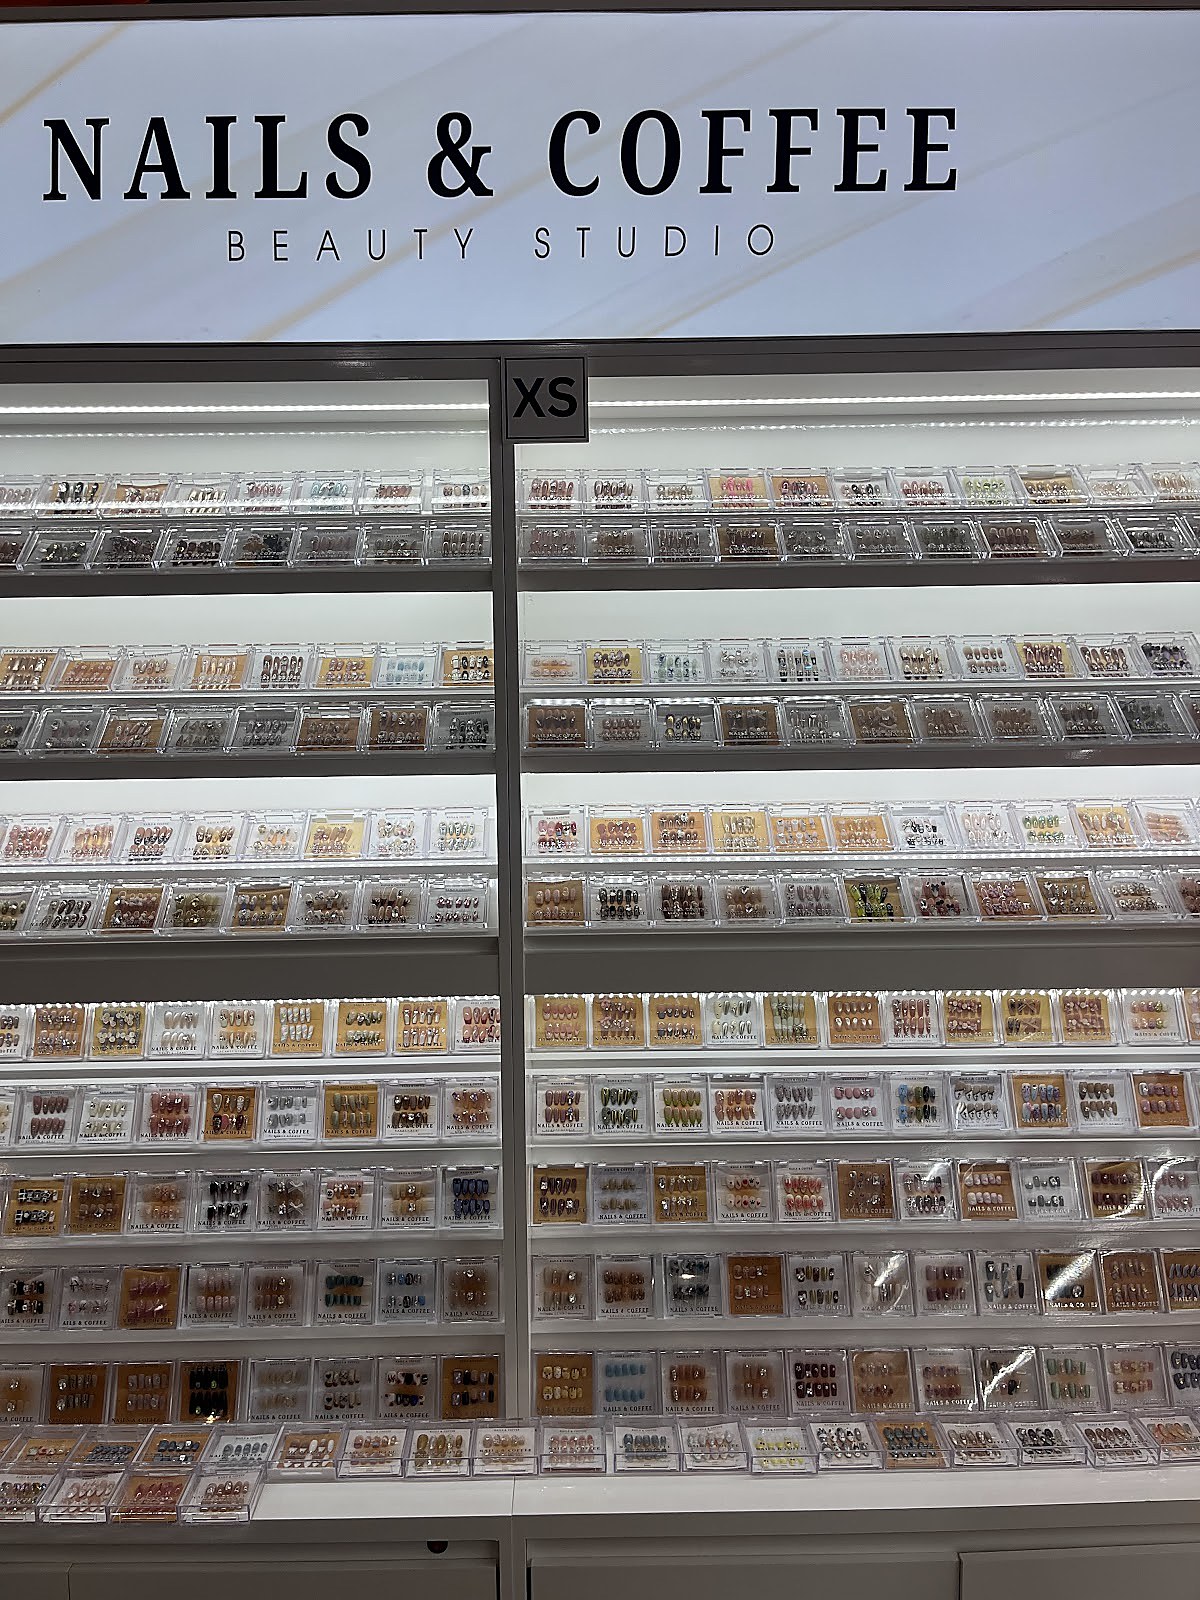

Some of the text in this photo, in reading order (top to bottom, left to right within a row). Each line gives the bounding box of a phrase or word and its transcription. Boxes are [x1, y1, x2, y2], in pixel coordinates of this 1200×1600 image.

[43, 108, 956, 200] NAILS & COFFEE
[228, 224, 773, 261] BEAUTY STUDIO
[513, 377, 577, 417] XS
